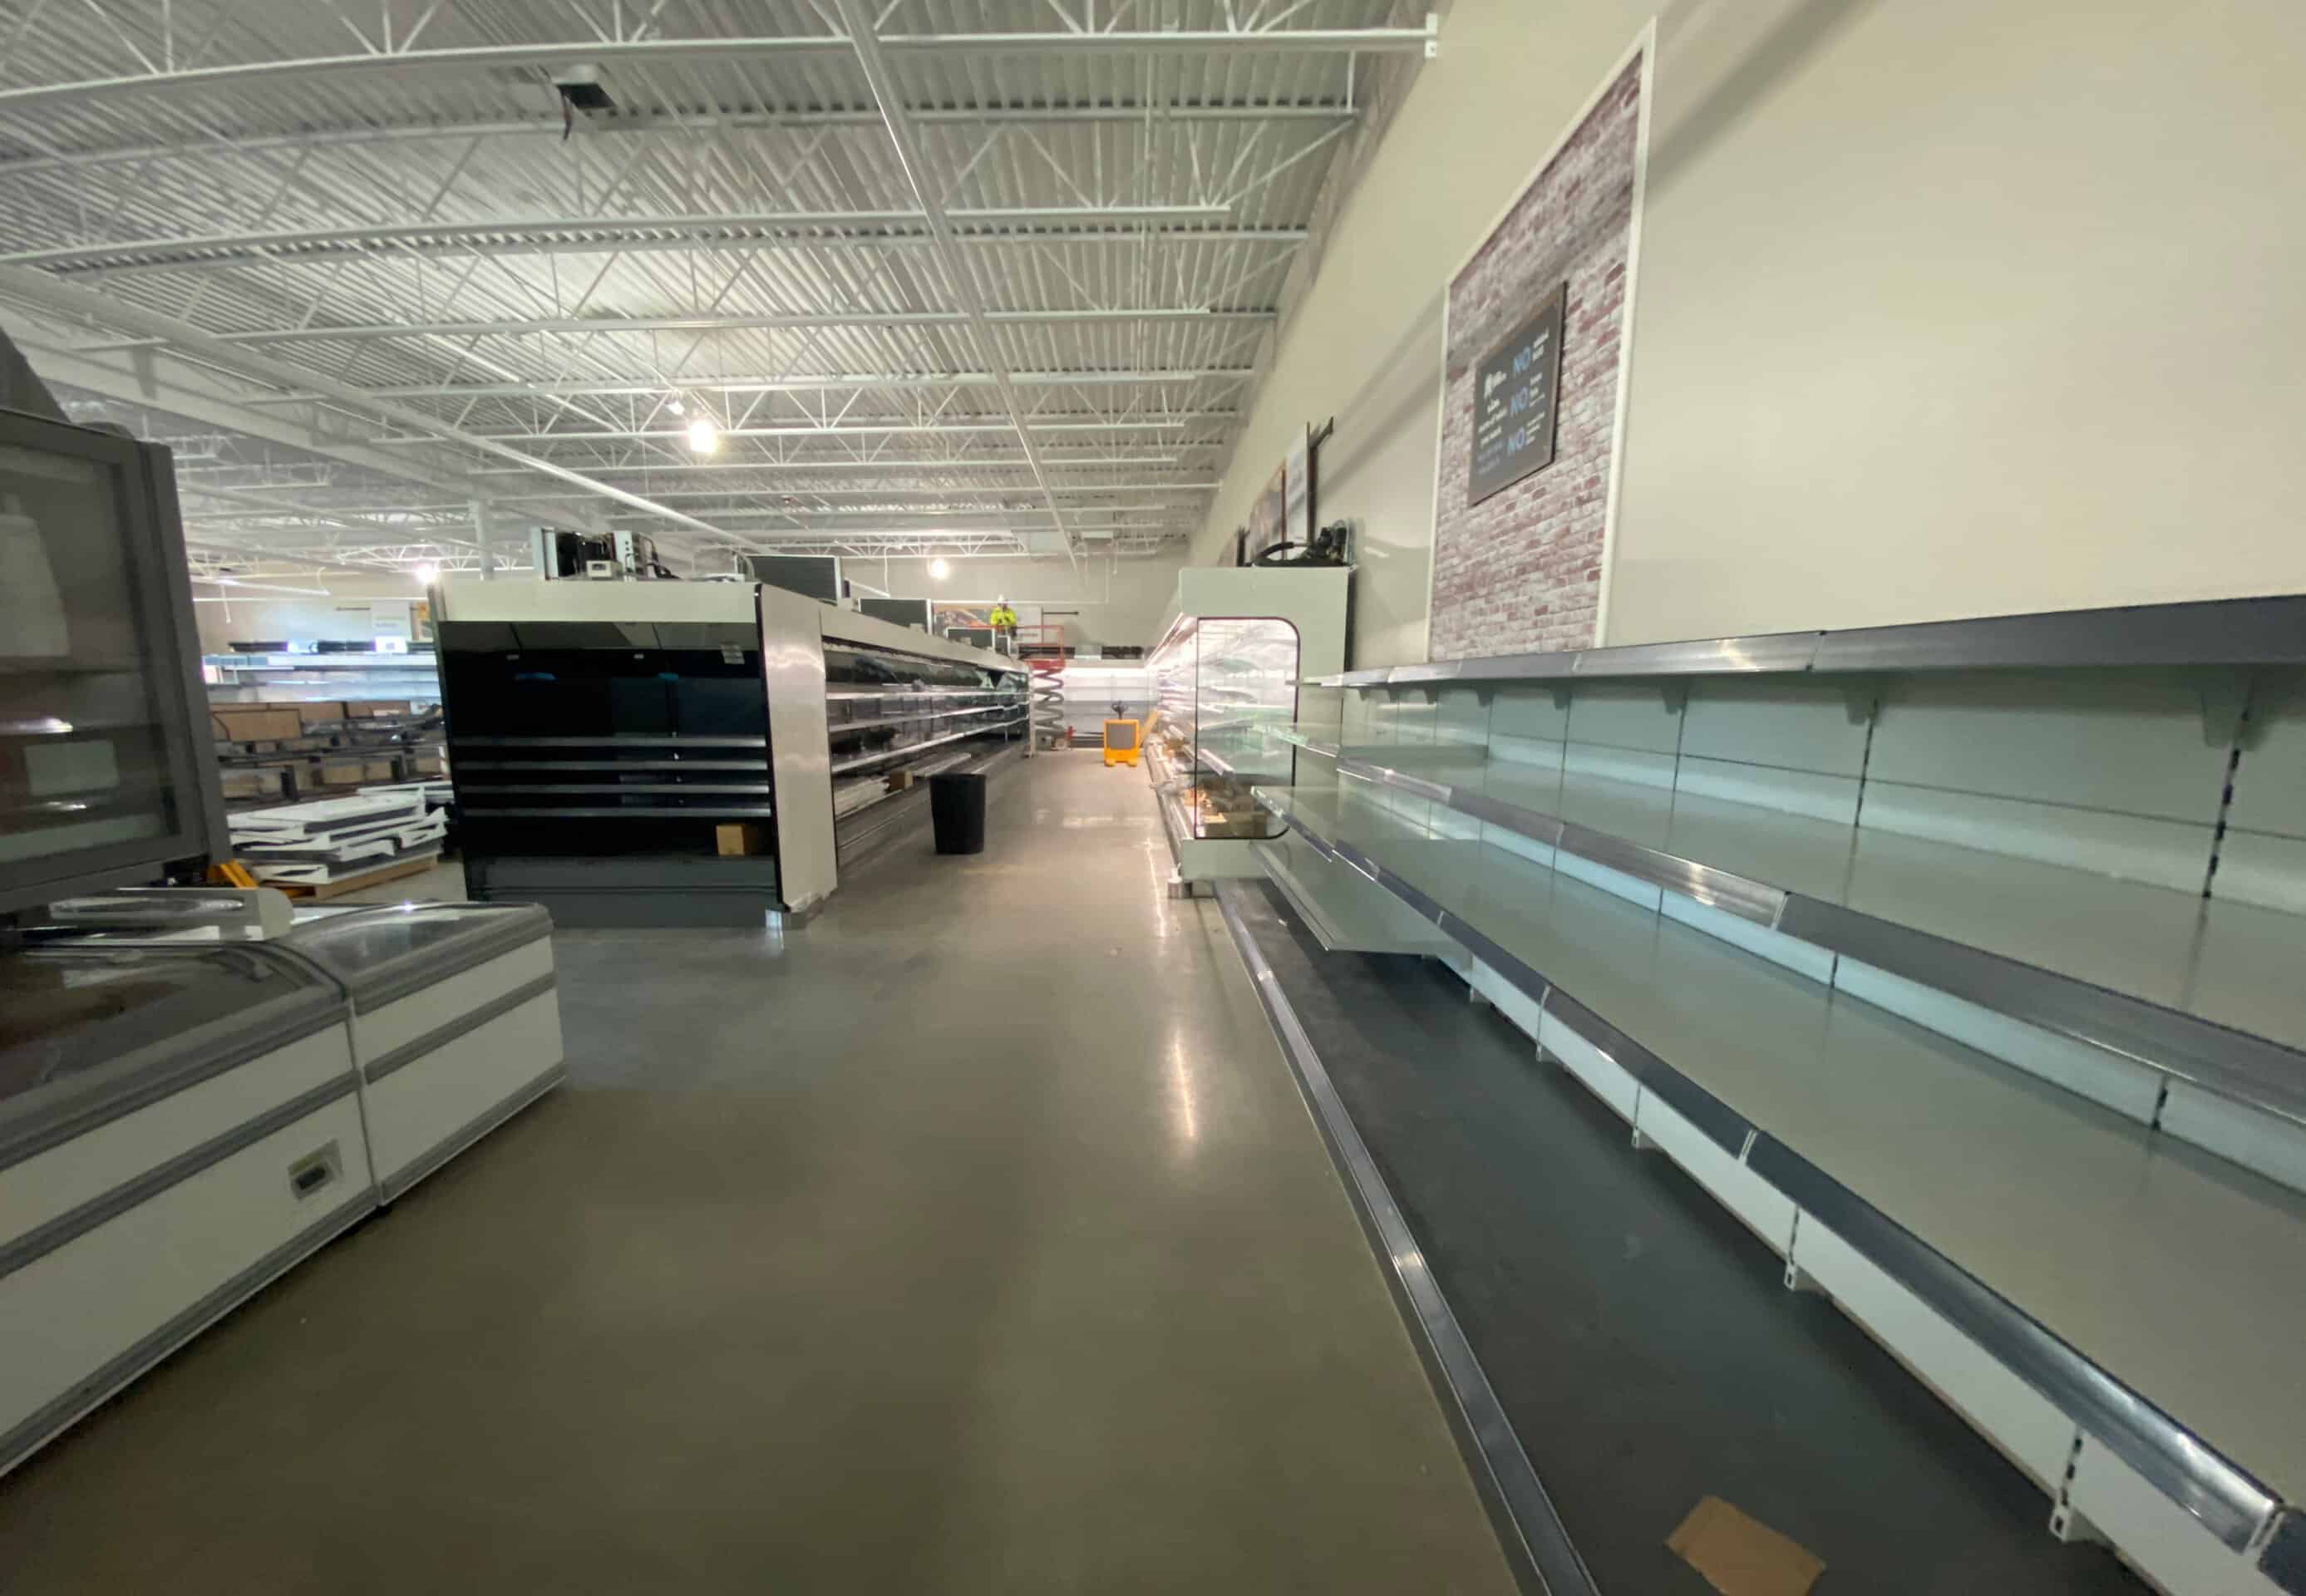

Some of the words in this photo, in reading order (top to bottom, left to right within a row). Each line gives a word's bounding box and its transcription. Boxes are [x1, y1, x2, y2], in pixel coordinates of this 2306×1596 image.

[1513, 346, 1530, 374] NO
[1510, 386, 1529, 416] NO
[1507, 426, 1525, 455] NO
